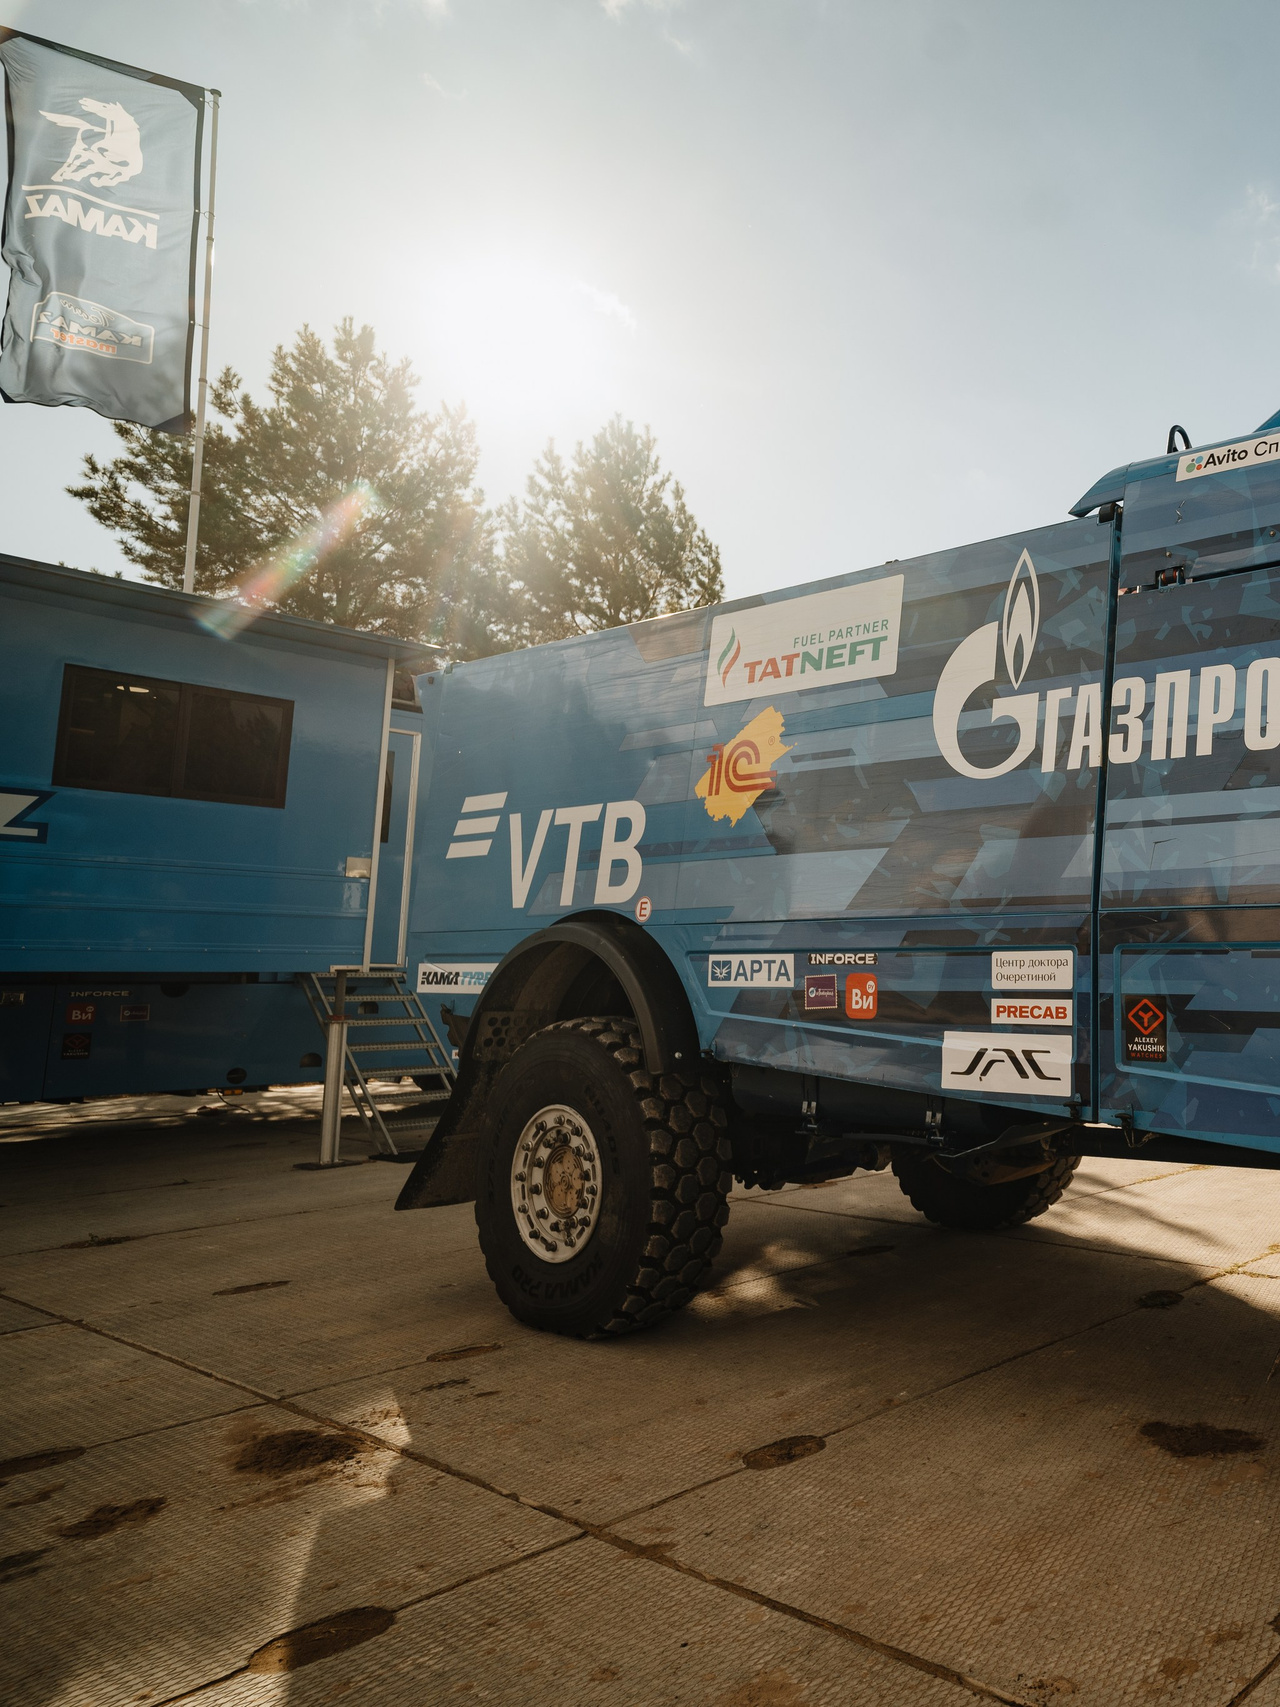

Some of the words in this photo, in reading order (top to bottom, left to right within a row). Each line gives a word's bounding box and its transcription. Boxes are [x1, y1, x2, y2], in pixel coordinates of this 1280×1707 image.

[1204, 448, 1248, 468] Avito
[793, 632, 824, 648] FUEL
[828, 619, 889, 642] PARTNER
[743, 635, 888, 684] TATNEFT
[509, 800, 646, 908] VTB
[639, 901, 648, 917] E
[810, 952, 875, 965] INFORCE
[995, 957, 1026, 969] Центр
[1028, 957, 1069, 969] доктора
[733, 959, 791, 982] АРТА
[995, 971, 1056, 983] Очеретиной
[421, 971, 460, 986] KAMA
[461, 971, 492, 986] TYRE
[996, 1005, 1067, 1020] PRECAB
[1128, 1044, 1165, 1052] YAKUSHIK
